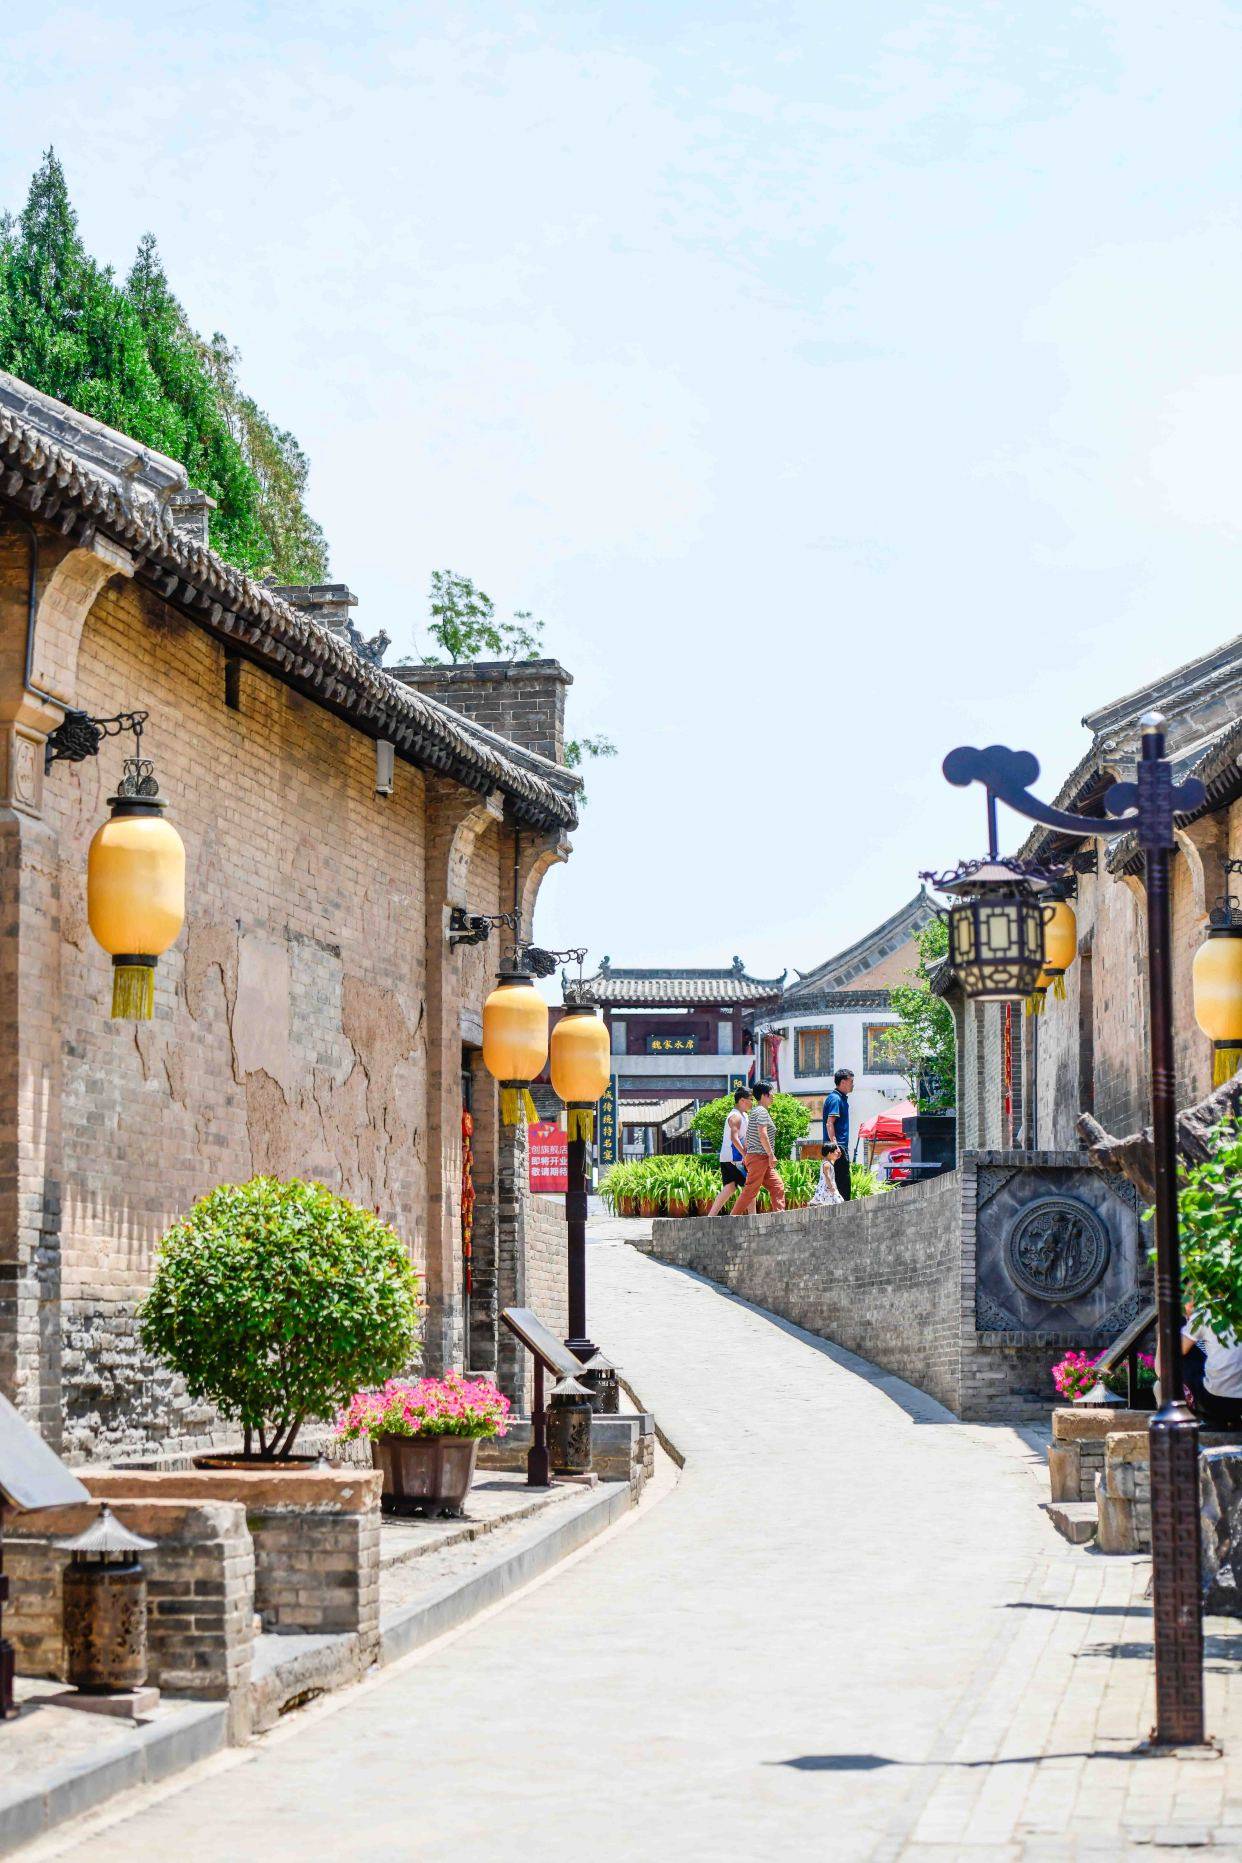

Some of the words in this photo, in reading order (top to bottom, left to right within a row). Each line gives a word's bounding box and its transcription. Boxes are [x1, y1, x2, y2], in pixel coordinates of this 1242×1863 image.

[602, 1083, 613, 1161] 城传统特名宴
[529, 1145, 568, 1155] 创旗舰店
[531, 1156, 568, 1166] 即将开业
[531, 1167, 568, 1177] 敬请期待
